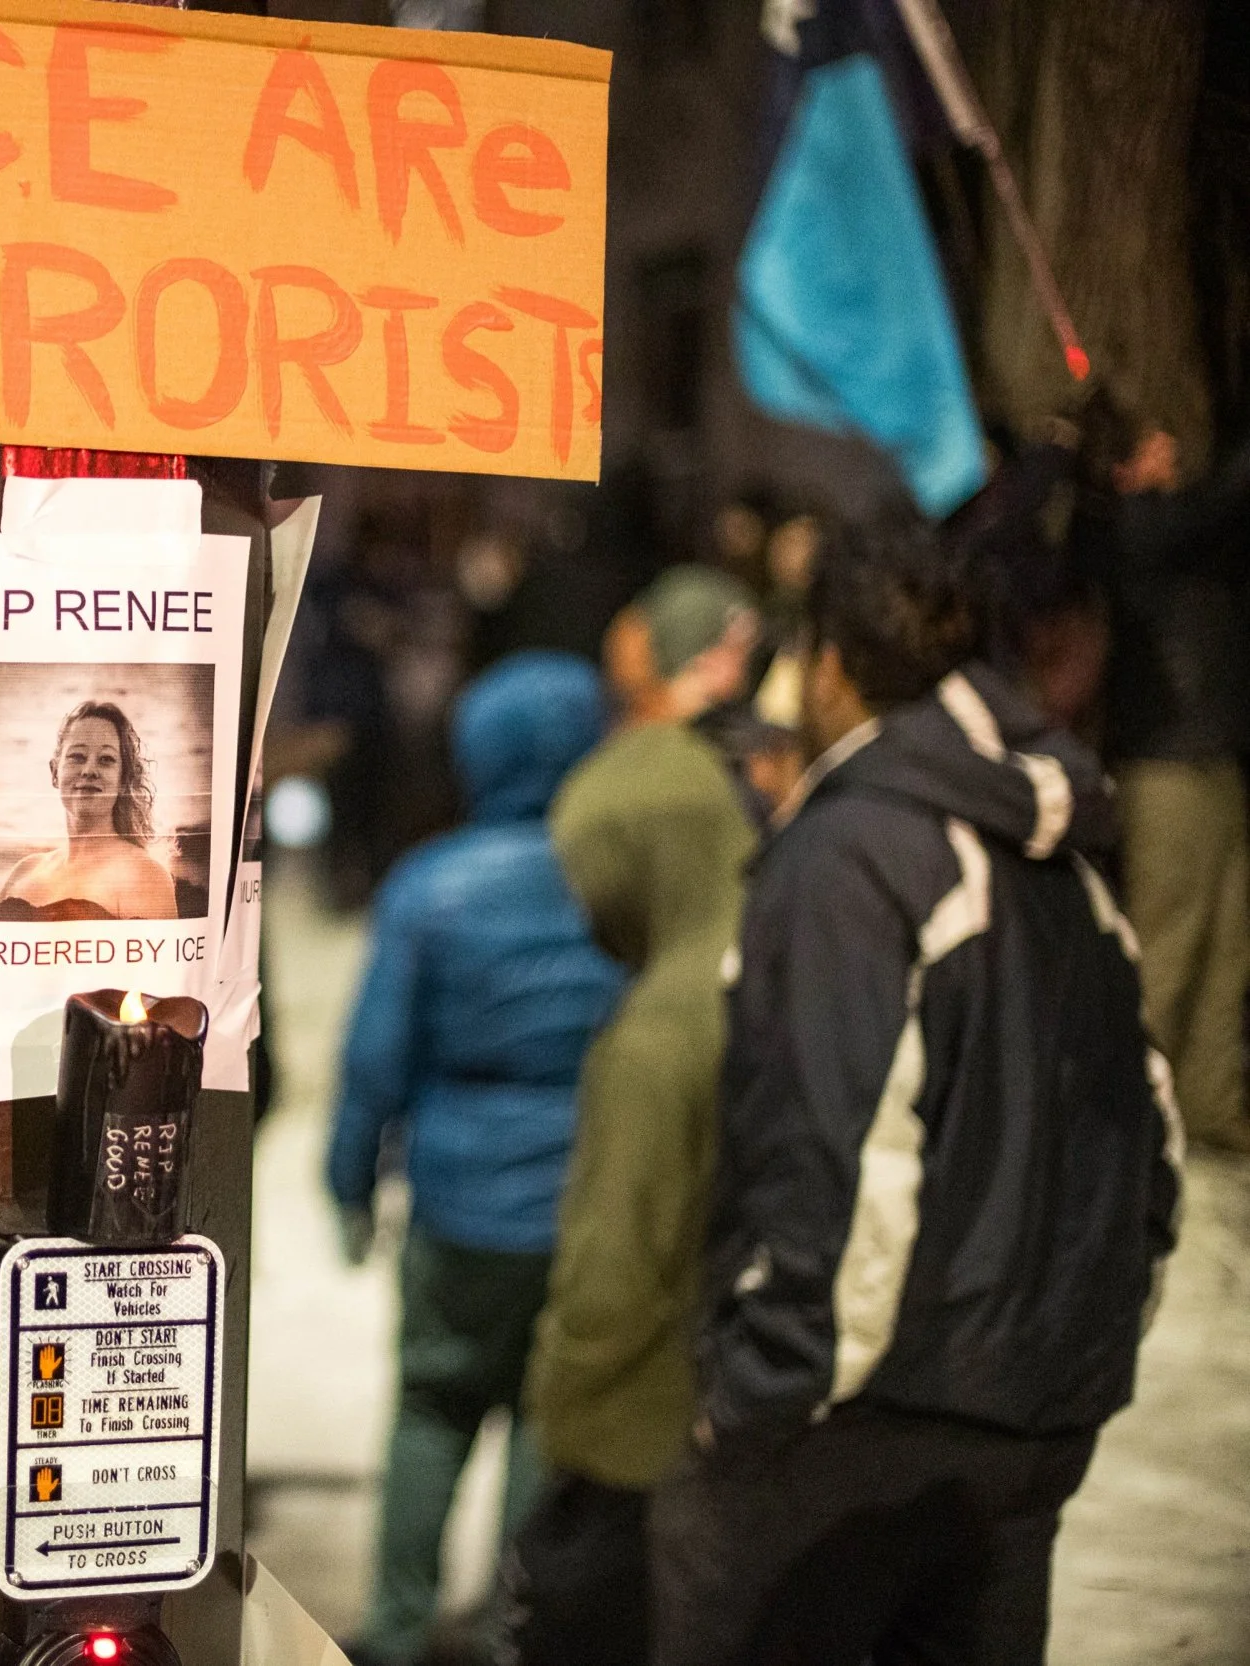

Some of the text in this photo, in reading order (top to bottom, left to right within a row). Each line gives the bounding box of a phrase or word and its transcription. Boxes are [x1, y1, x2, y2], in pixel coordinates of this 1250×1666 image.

[56, 590, 213, 632] RENEE
[126, 939, 165, 963] BY
[176, 936, 205, 962] ICE
[158, 1123, 177, 1173] RIP
[84, 1259, 192, 1278] START CROSSING
[106, 1282, 168, 1298] Watch For
[114, 1301, 161, 1316] Vehicles
[96, 1328, 177, 1346] DON'T START
[91, 1352, 182, 1367] Finish Crossing
[107, 1369, 165, 1385] If Started
[82, 1395, 188, 1414] TIME REMAINING
[80, 1416, 190, 1433] To Finish Crossing
[37, 1430, 57, 1439] TIMER
[34, 1457, 58, 1465] STEADY
[93, 1466, 176, 1484] DON'T CROSS
[53, 1520, 163, 1540] PUSH BUTTON
[68, 1551, 147, 1569] TO CROSS
